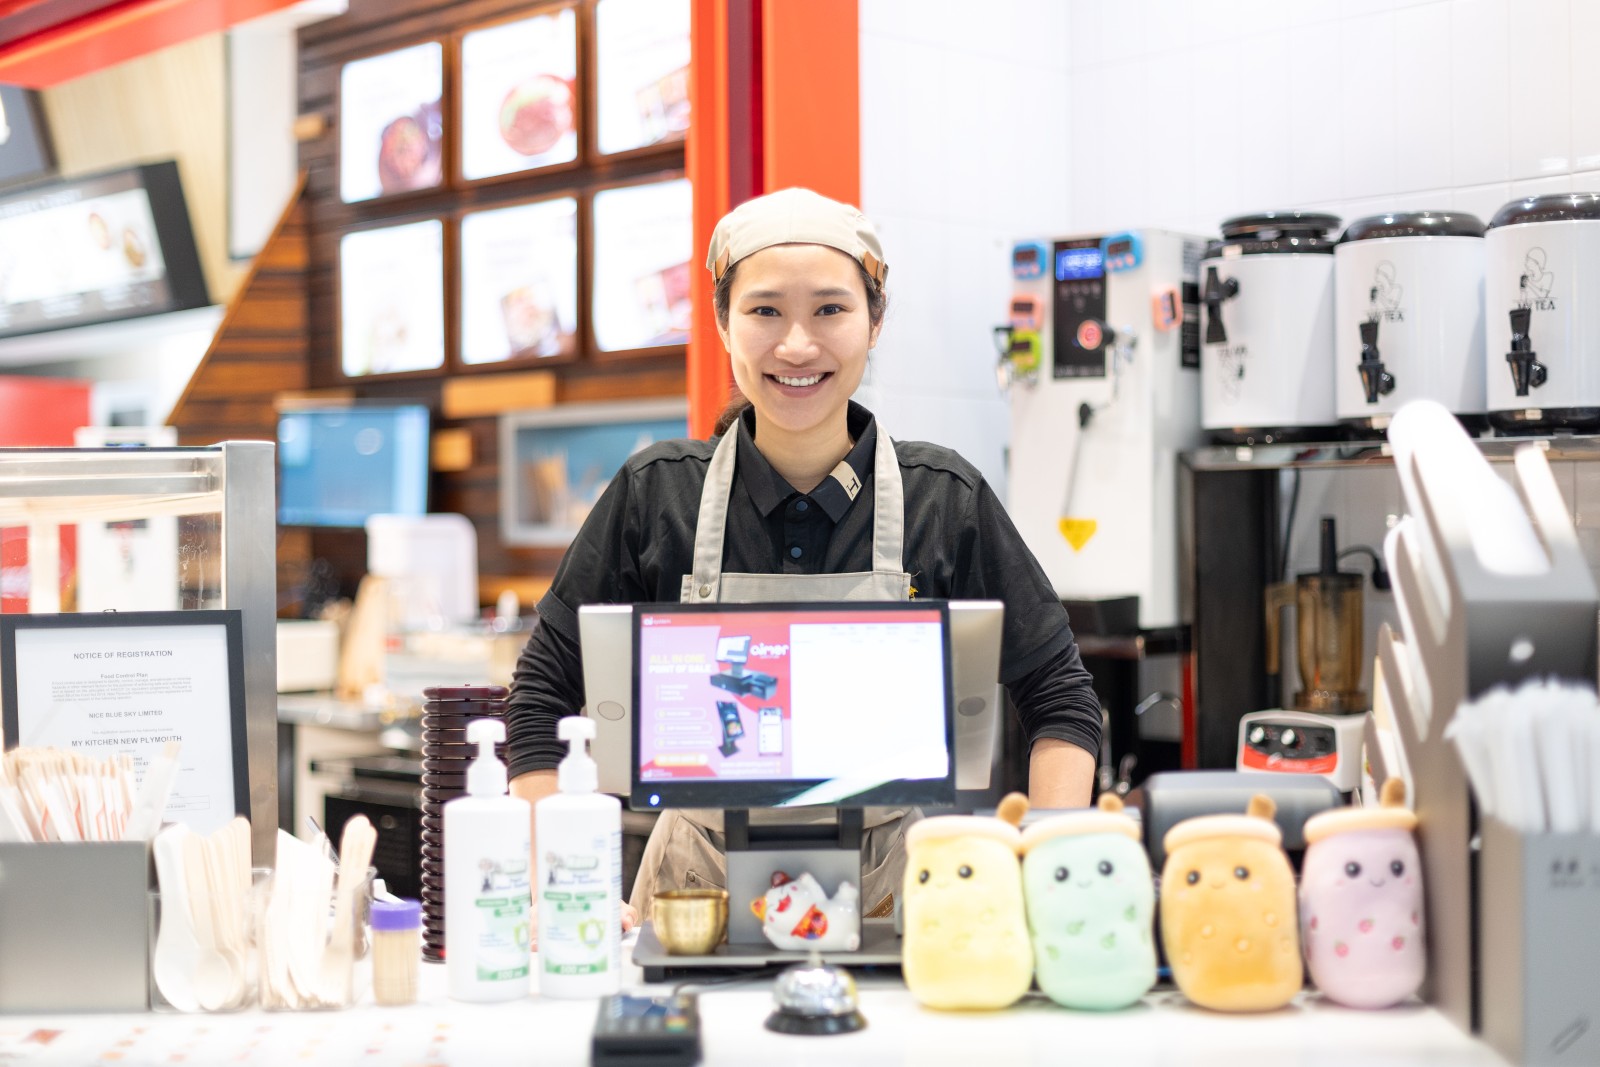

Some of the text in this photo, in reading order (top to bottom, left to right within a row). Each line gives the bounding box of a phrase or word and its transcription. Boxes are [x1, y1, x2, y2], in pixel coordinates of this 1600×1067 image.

[1535, 299, 1556, 311] TEA
[1384, 310, 1404, 322] TEA
[846, 476, 859, 497] H
[73, 650, 173, 660] NOTICE OF REGISTRATION
[84, 738, 119, 746] KITCHEN
[120, 737, 138, 745] NEW
[140, 735, 182, 744] PLYMOUTH
